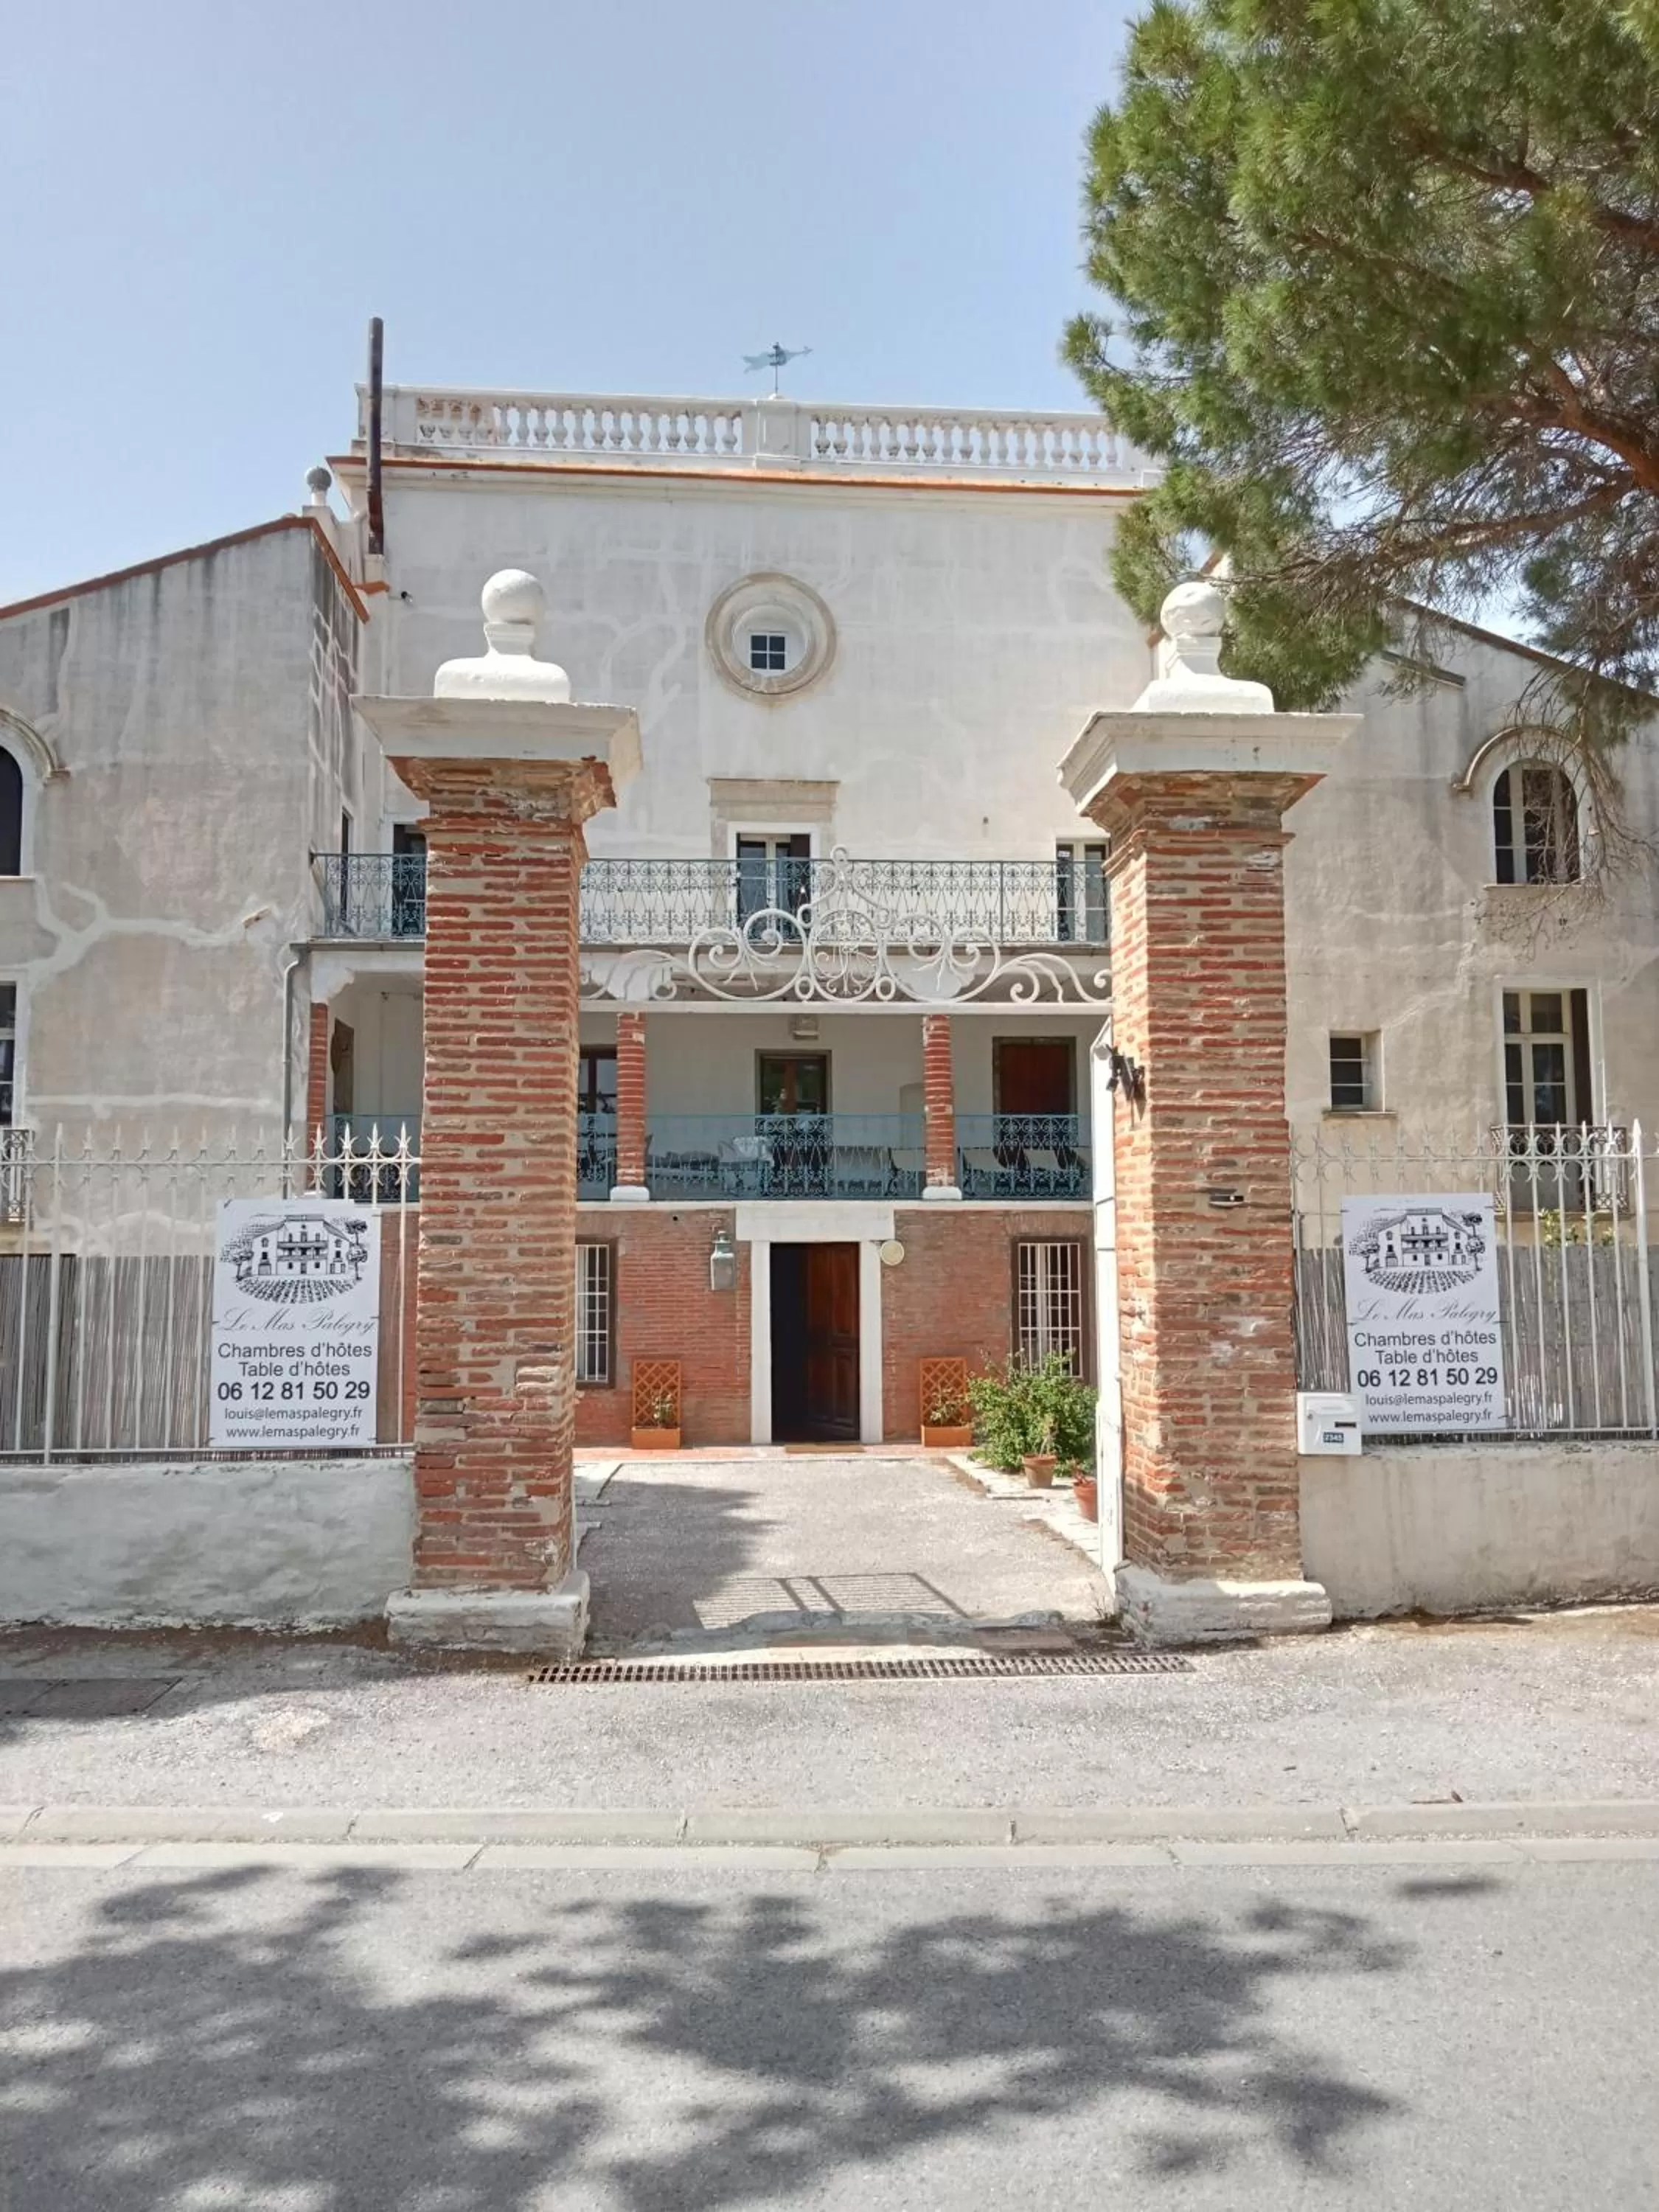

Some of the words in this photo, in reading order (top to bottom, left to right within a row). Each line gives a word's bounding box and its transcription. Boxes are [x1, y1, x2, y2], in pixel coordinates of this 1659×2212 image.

[1385, 1301, 1425, 1321] Mas
[252, 1309, 295, 1332] Mas
[1354, 1332, 1436, 1346] Chambres
[1441, 1332, 1496, 1345] d'hôtes
[218, 1343, 305, 1357] Chambres
[311, 1343, 372, 1357] d'hôtes
[1376, 1350, 1417, 1364] Table
[1423, 1349, 1478, 1363] d'hôtes
[239, 1362, 283, 1377] Table
[289, 1361, 350, 1376] d'hôtes
[1357, 1370, 1381, 1387] 06
[1389, 1369, 1411, 1386] 12
[1417, 1368, 1438, 1385] 81
[1447, 1368, 1469, 1385] 50
[1475, 1367, 1498, 1384] 29
[218, 1383, 242, 1400] 06
[251, 1383, 274, 1399] 12
[282, 1382, 304, 1399] 81
[313, 1382, 338, 1399] 50
[345, 1381, 370, 1399] 29
[1366, 1392, 1492, 1405] louis@lemaspalegry.fr
[225, 1406, 363, 1422] louis@lemaspalegry.fr
[1368, 1409, 1492, 1423] www.lemaspalegry.fr
[226, 1424, 360, 1439] www.lemaspalegry.fr
